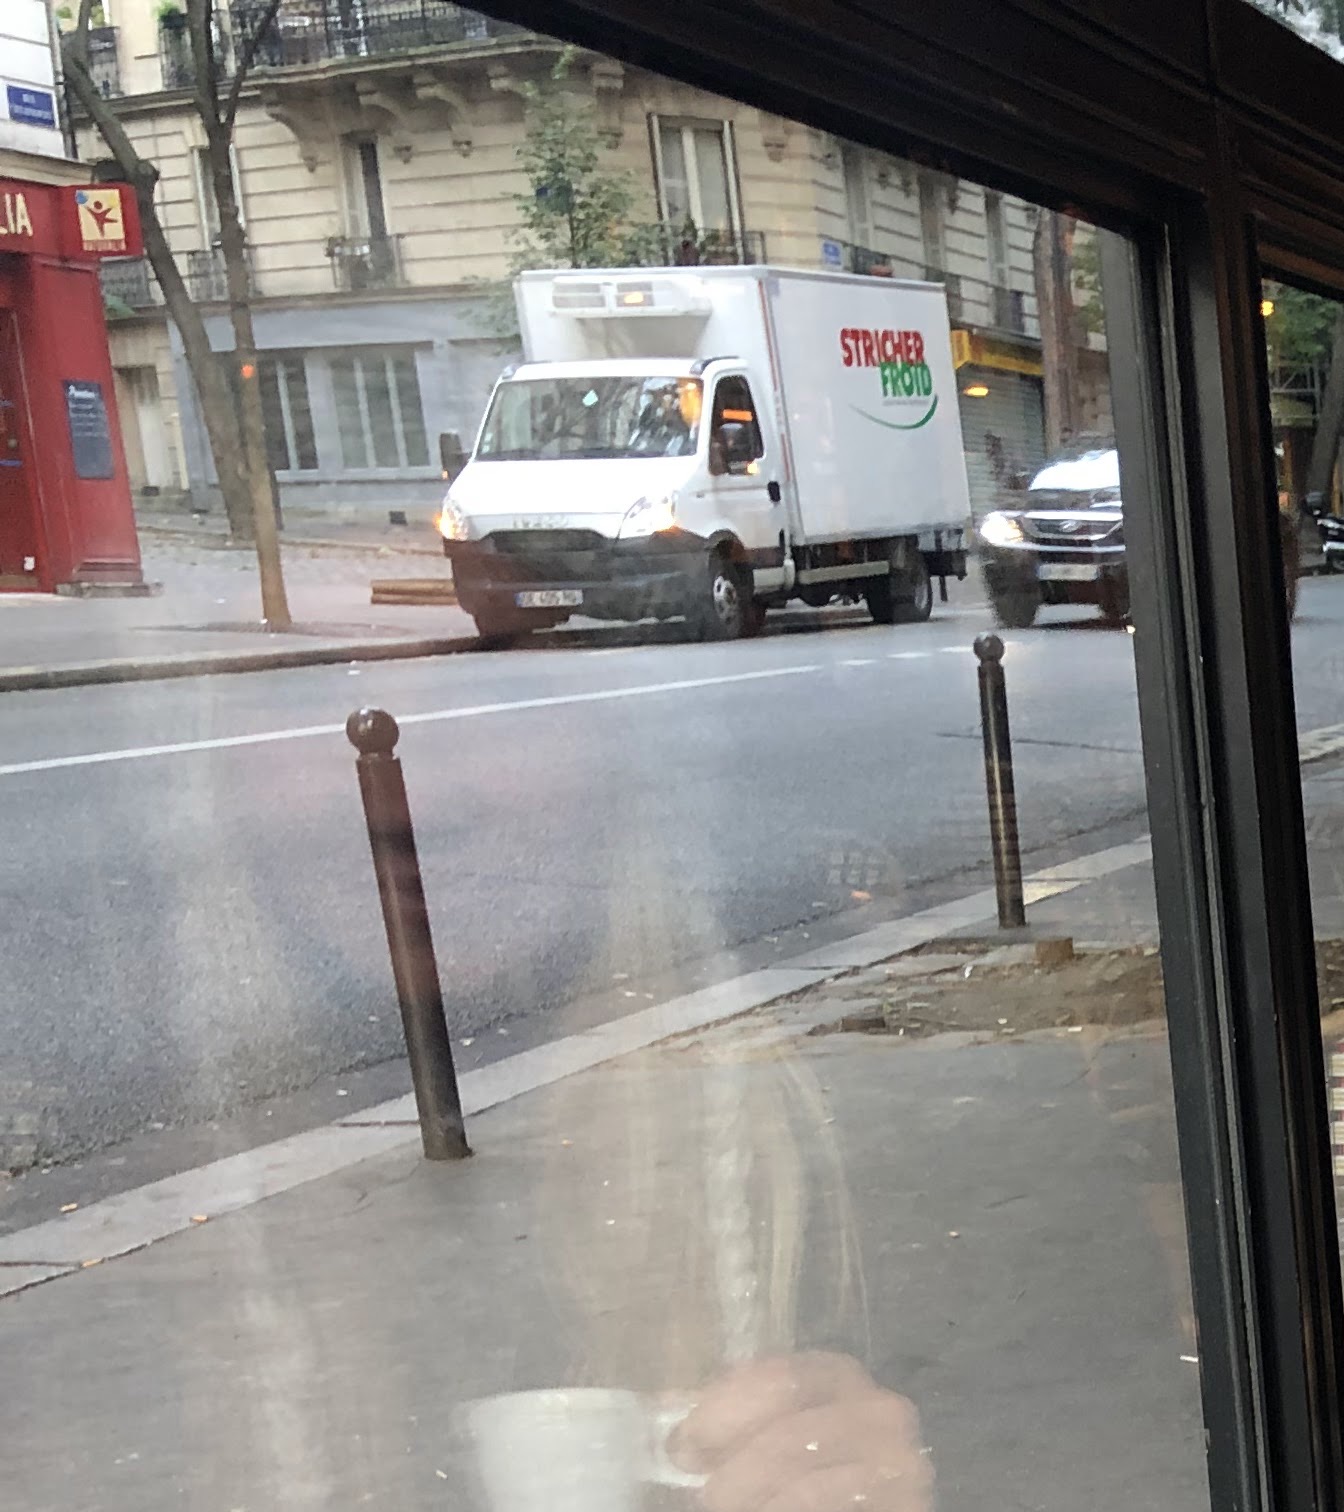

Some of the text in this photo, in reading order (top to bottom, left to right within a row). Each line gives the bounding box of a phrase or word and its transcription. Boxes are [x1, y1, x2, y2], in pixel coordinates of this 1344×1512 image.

[0, 193, 33, 236] IA
[841, 328, 924, 367] STRICHER
[880, 362, 932, 397] FROID
